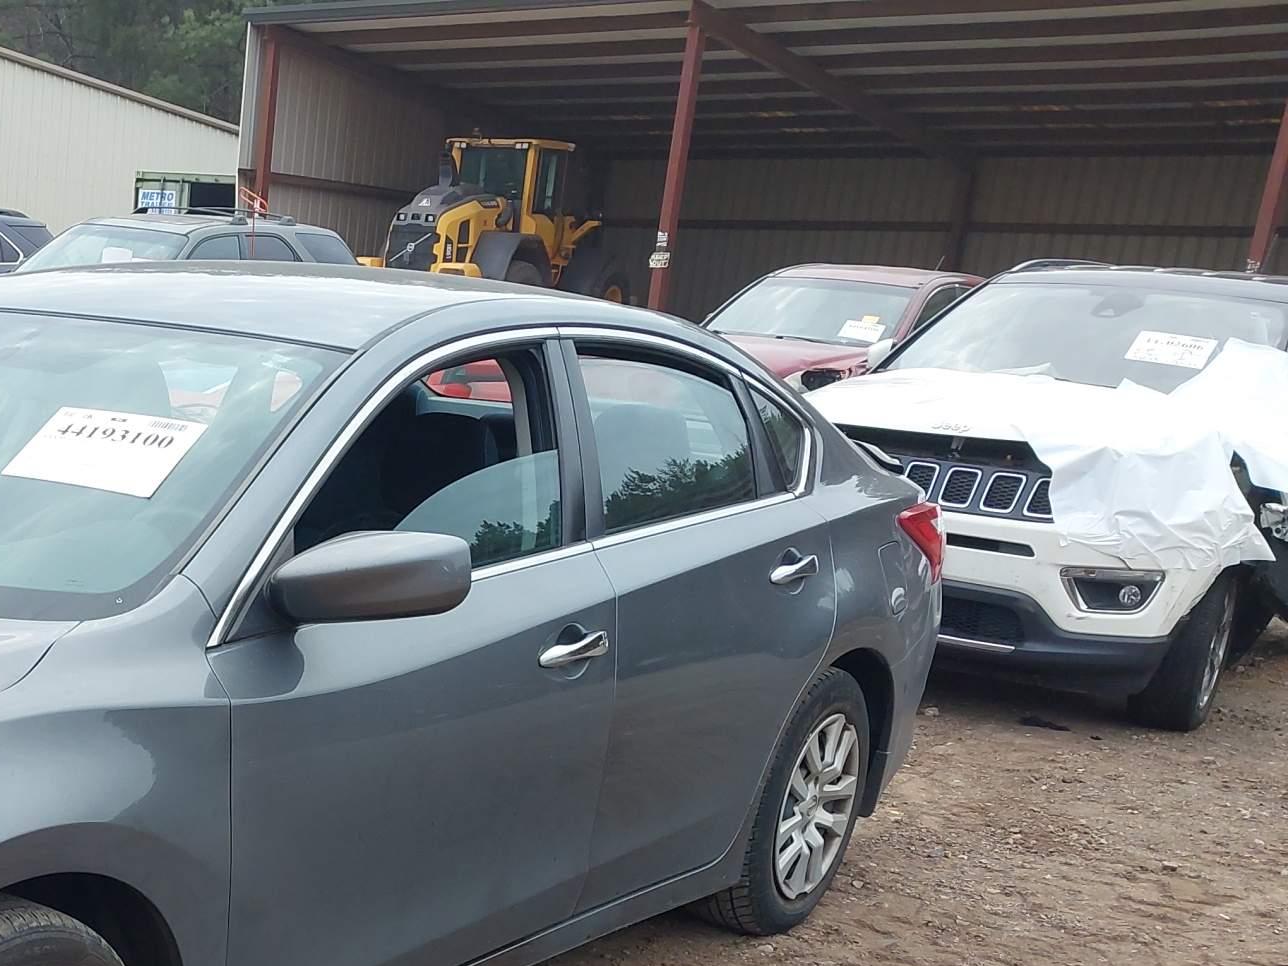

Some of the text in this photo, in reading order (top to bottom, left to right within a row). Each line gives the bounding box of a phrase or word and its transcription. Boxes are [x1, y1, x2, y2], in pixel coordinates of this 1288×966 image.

[141, 191, 174, 202] METRO
[931, 421, 971, 434] Jeep
[57, 423, 175, 449] 44193100
